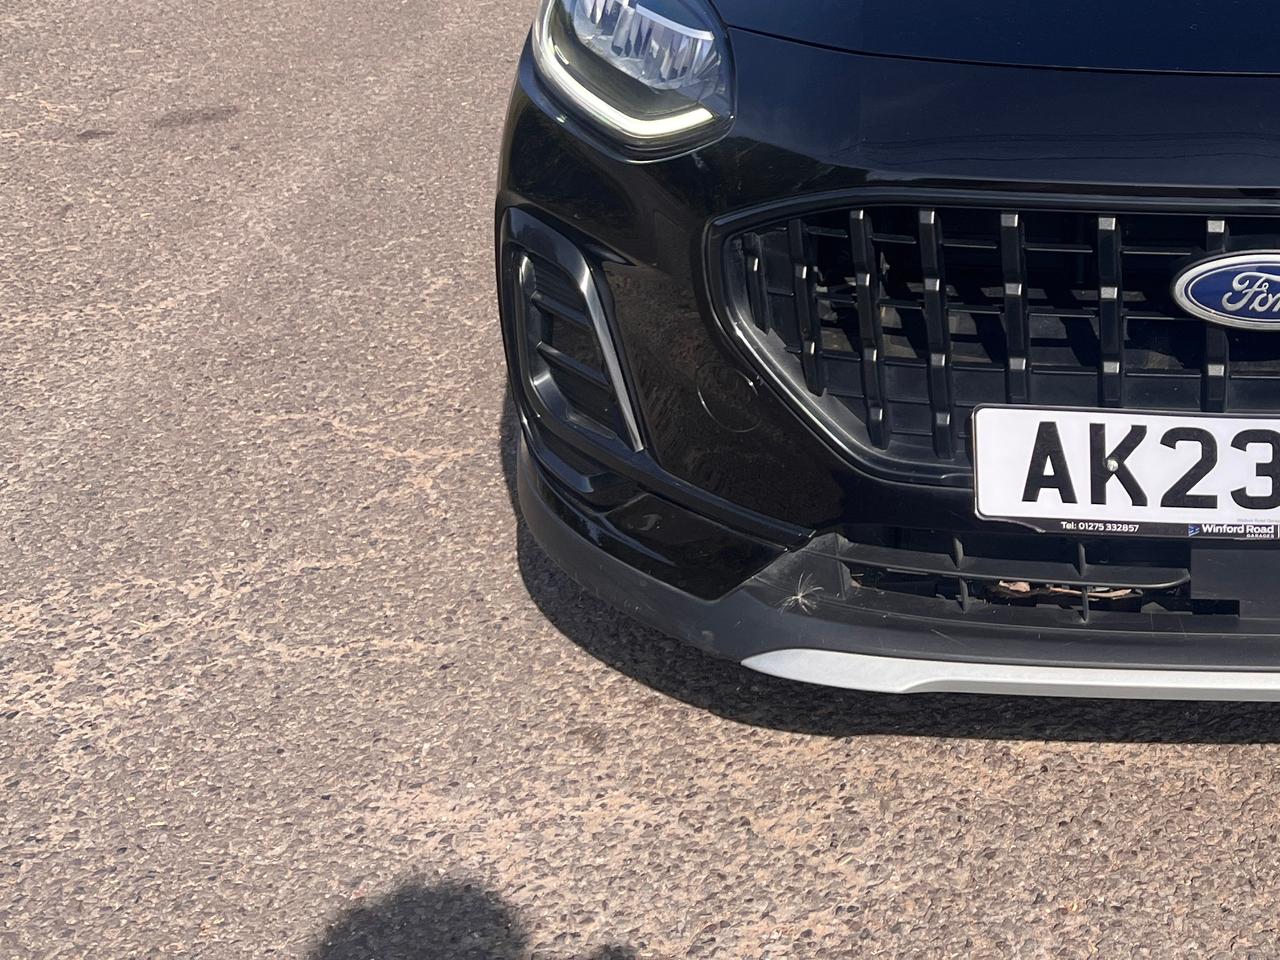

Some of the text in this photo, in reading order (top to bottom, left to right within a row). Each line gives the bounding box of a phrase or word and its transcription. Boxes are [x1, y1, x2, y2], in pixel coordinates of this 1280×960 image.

[1060, 521, 1139, 532] Tel: 01275 332857
[1202, 524, 1274, 533] Winford Road
